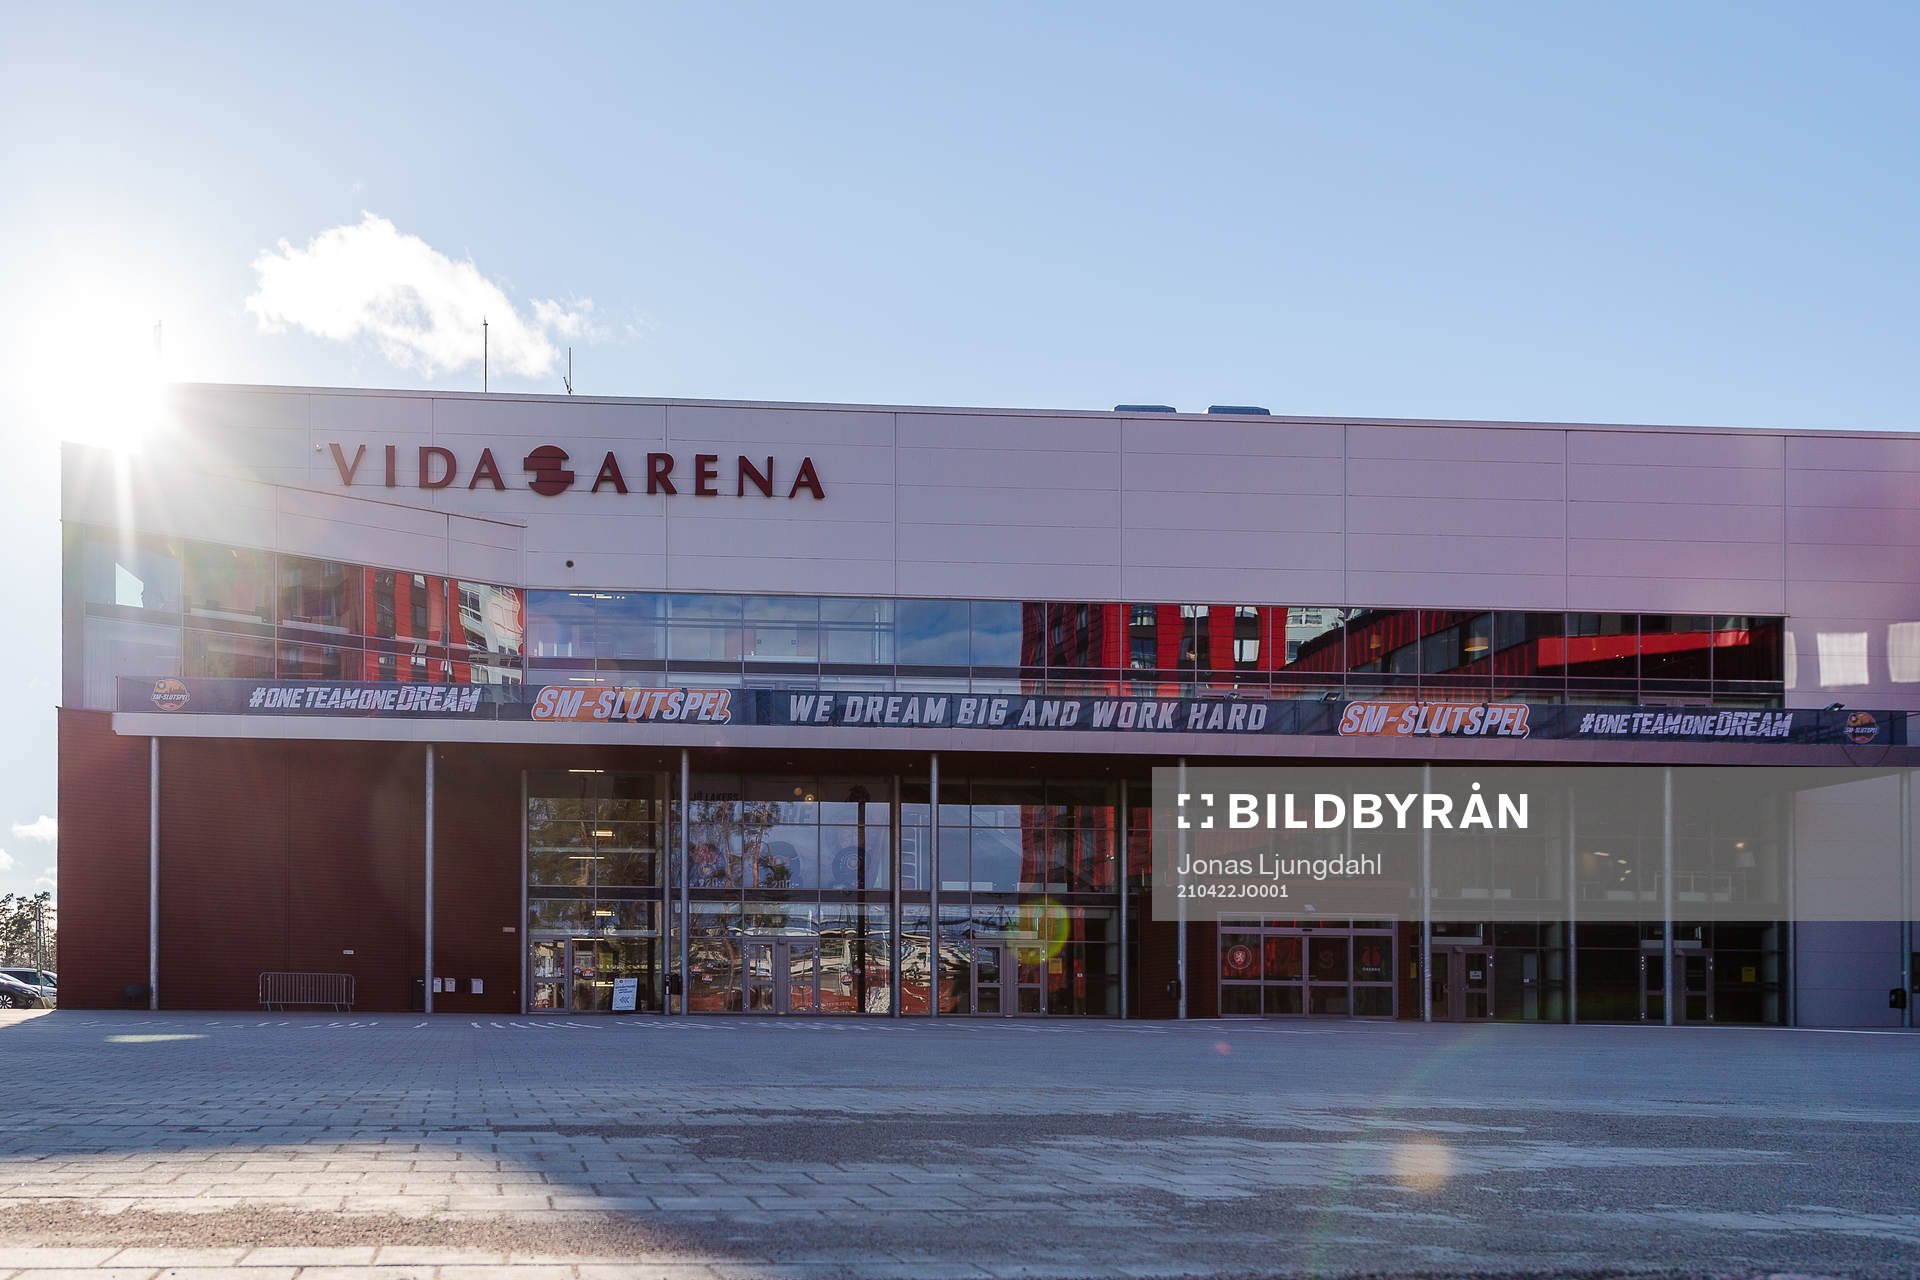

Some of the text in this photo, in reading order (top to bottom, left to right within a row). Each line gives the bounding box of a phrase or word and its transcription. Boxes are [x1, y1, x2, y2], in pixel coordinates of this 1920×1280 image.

[329, 443, 826, 499] VIDA ARENA
[535, 688, 729, 722] SM-SLUTSPEL
[789, 695, 1268, 732] WE DREAM BIG AND WORK HARD
[1340, 703, 1530, 737] SM-SLUTSPEL
